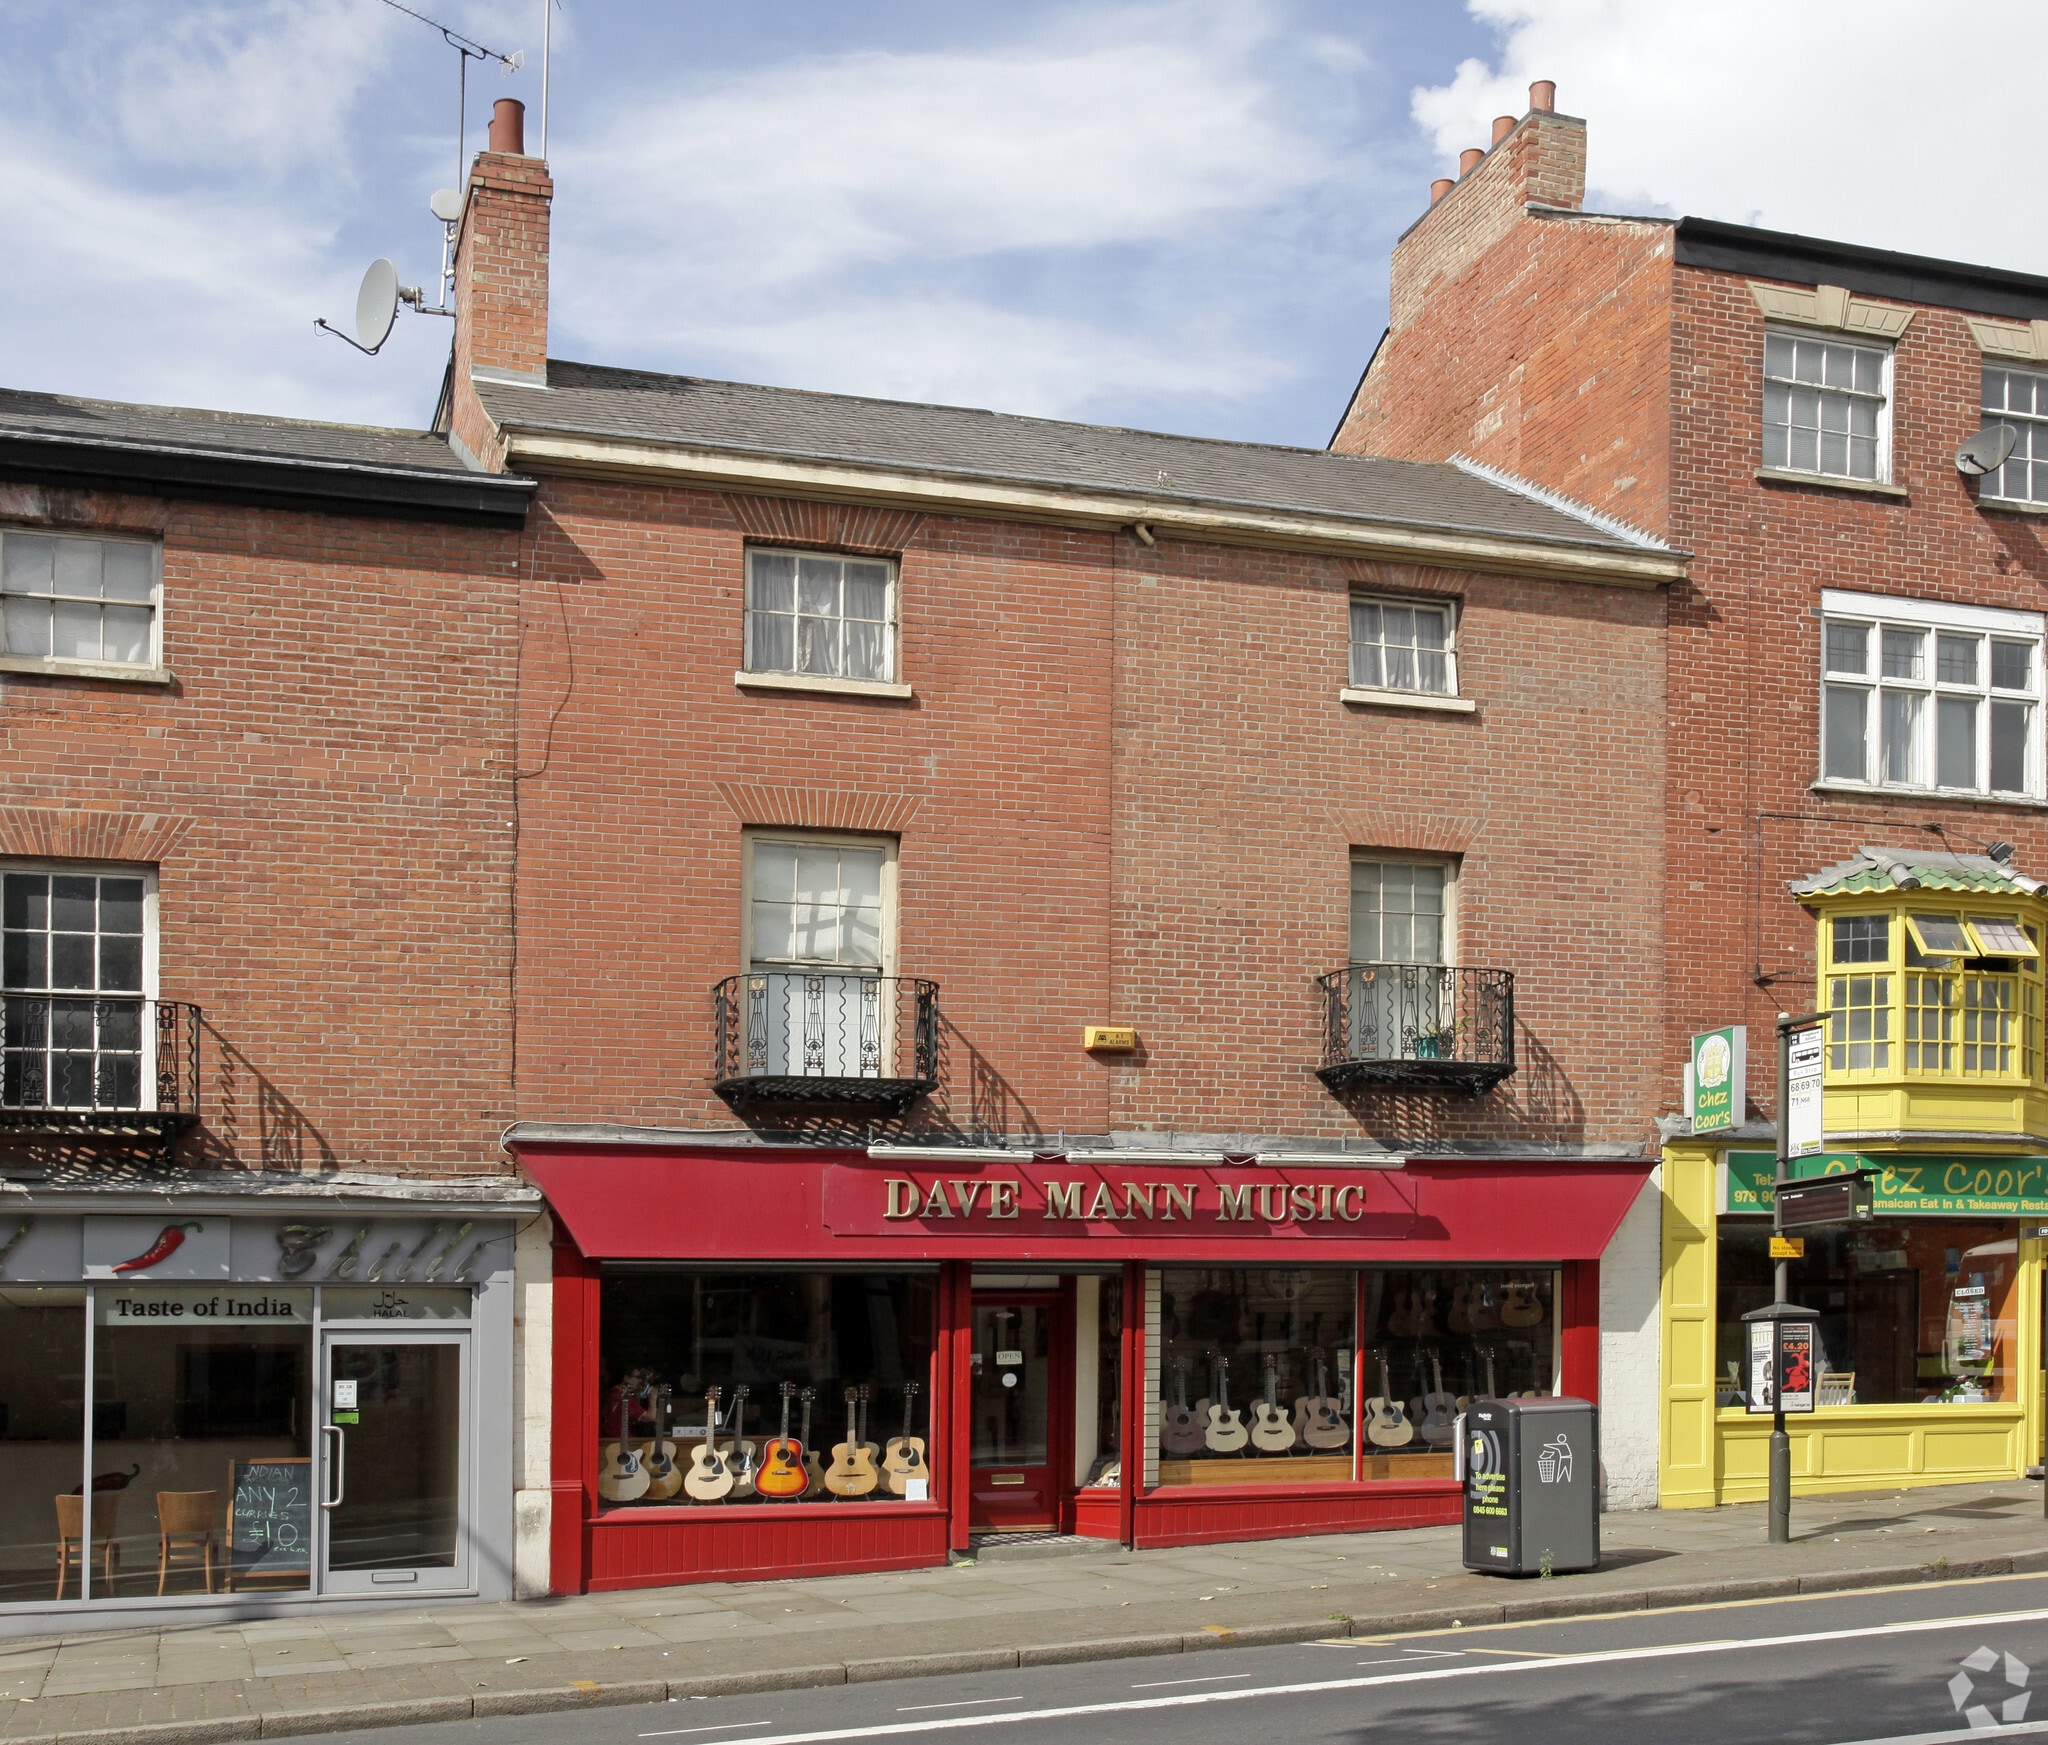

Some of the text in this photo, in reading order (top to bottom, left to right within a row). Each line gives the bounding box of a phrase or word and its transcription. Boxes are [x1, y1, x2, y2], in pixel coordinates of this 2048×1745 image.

[1791, 1079, 1820, 1092] 68 69 70
[1698, 1090, 1728, 1108] Chez
[1791, 1097, 1799, 1106] 71
[1695, 1110, 1731, 1129] Coor's
[1943, 1162, 2048, 1197] Coor'
[883, 1179, 1367, 1222] DAVE MANN MUSIC
[1735, 1190, 1758, 1203] 979
[1920, 1198, 1939, 1209] Eat
[1942, 1199, 1953, 1209] In
[1956, 1198, 1965, 1210] &
[1967, 1199, 2018, 1213] Takeaway
[1956, 1288, 1984, 1296] CLOSED
[116, 1297, 293, 1317] Taste of India
[373, 1309, 409, 1318] HALAL
[1783, 1342, 1809, 1350] £4.20
[1475, 1471, 1506, 1481] To advertise
[1475, 1483, 1506, 1493] here please
[236, 1486, 307, 1517] ANY 2
[1482, 1495, 1499, 1504] phone
[242, 1520, 298, 1548] £10
